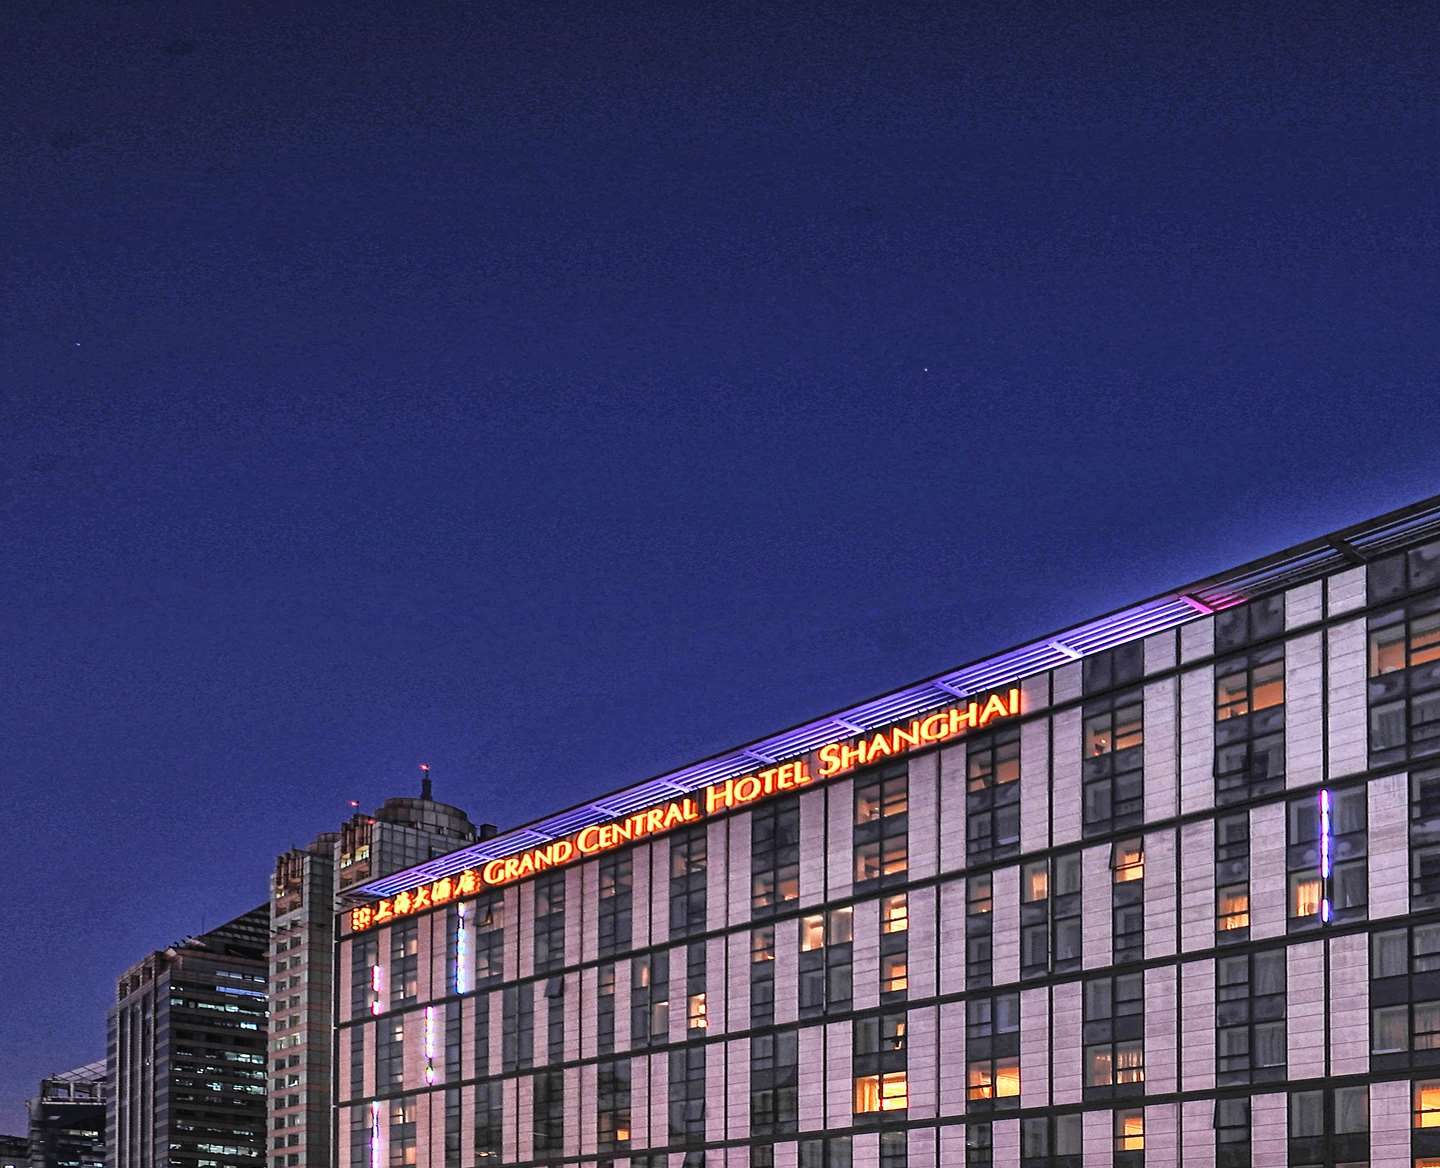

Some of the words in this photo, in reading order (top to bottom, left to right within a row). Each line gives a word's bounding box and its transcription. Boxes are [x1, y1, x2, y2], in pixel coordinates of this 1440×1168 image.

[482, 840, 573, 885] GRAND
[576, 798, 698, 853] CENTRAL
[706, 760, 810, 814] HOTEL
[818, 688, 1019, 776] SHANGHAI
